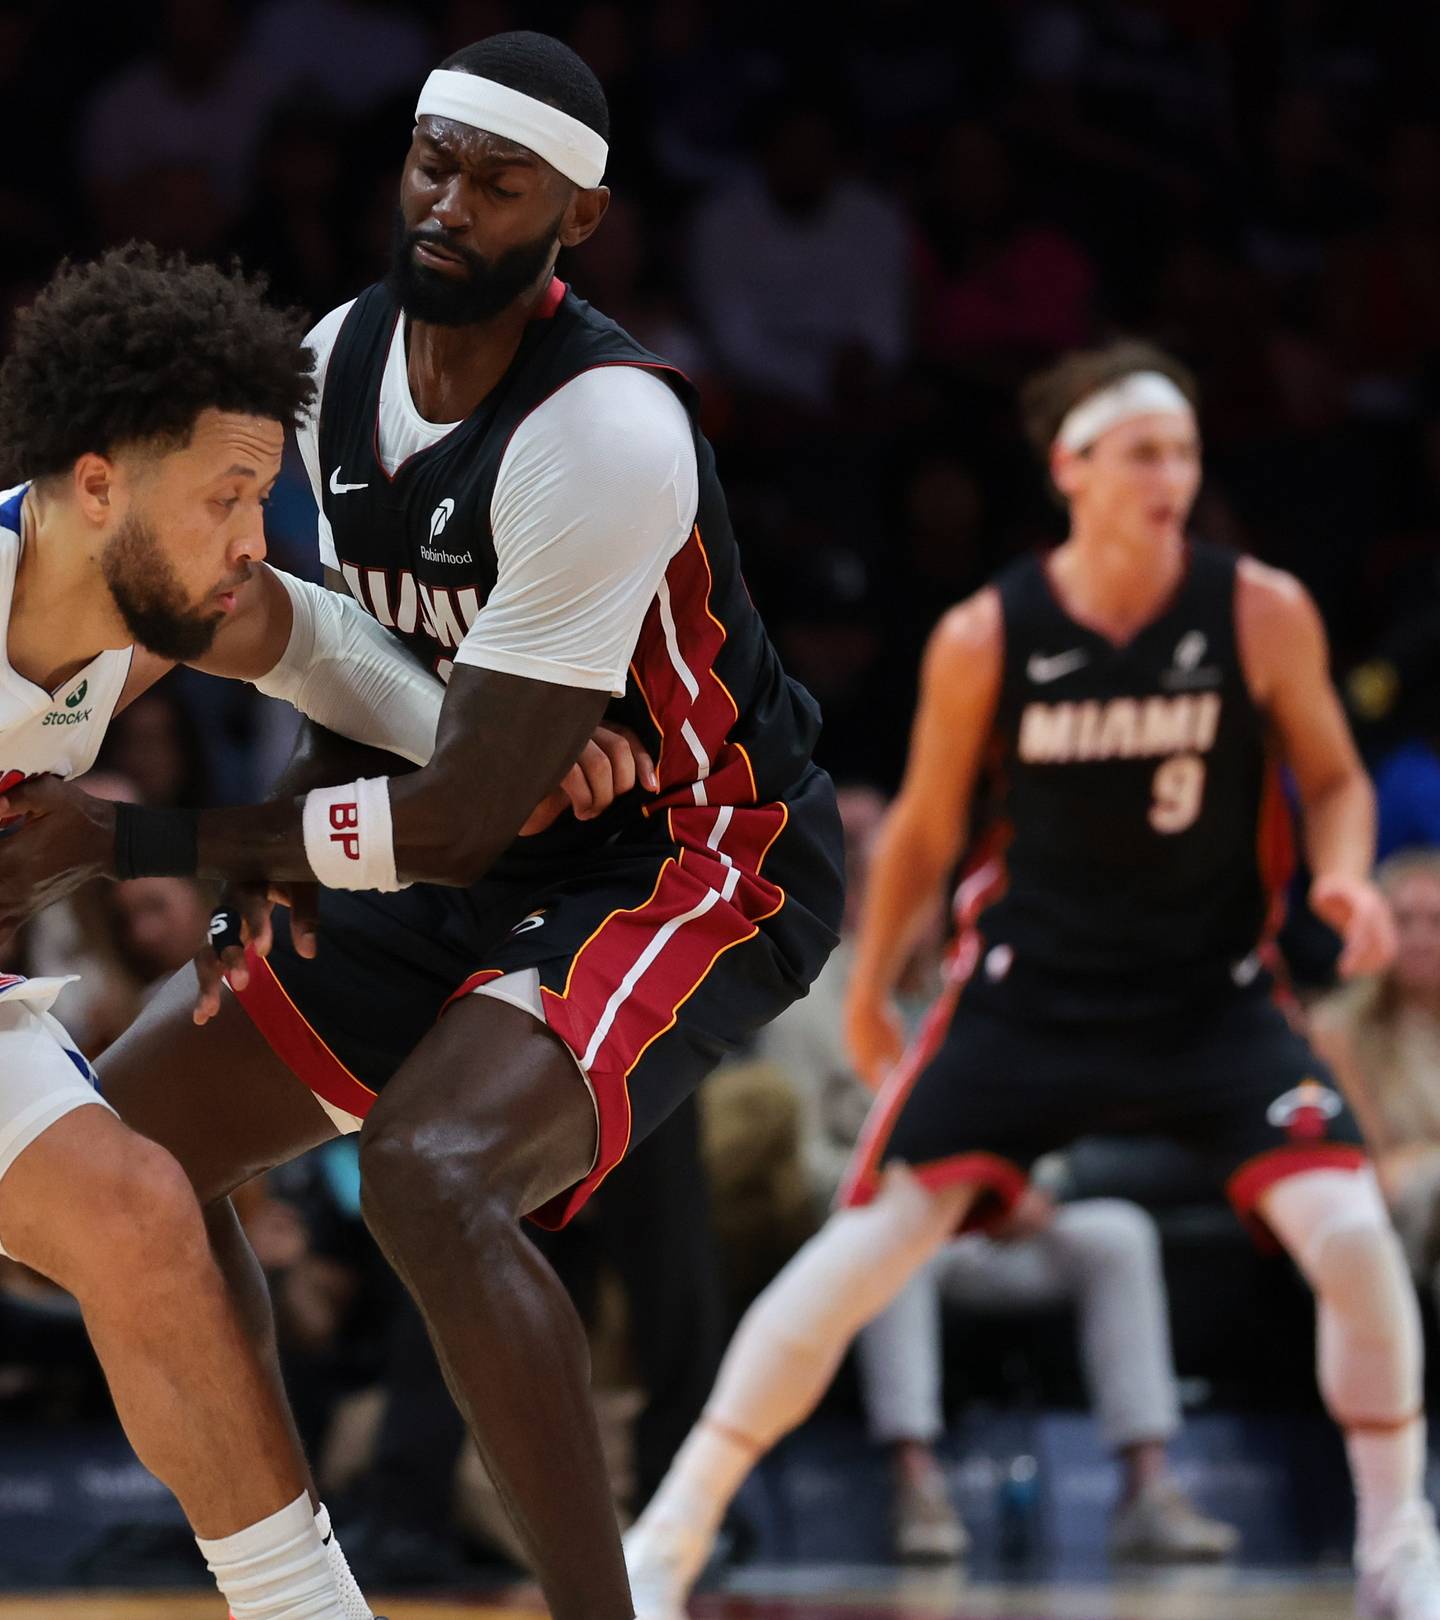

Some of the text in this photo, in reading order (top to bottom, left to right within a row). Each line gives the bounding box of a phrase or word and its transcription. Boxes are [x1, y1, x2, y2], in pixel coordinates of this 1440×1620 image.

[420, 545, 473, 565] Robinhood
[1017, 690, 1222, 764] MIAMI
[1147, 754, 1206, 834] 9
[329, 802, 360, 861] BP
